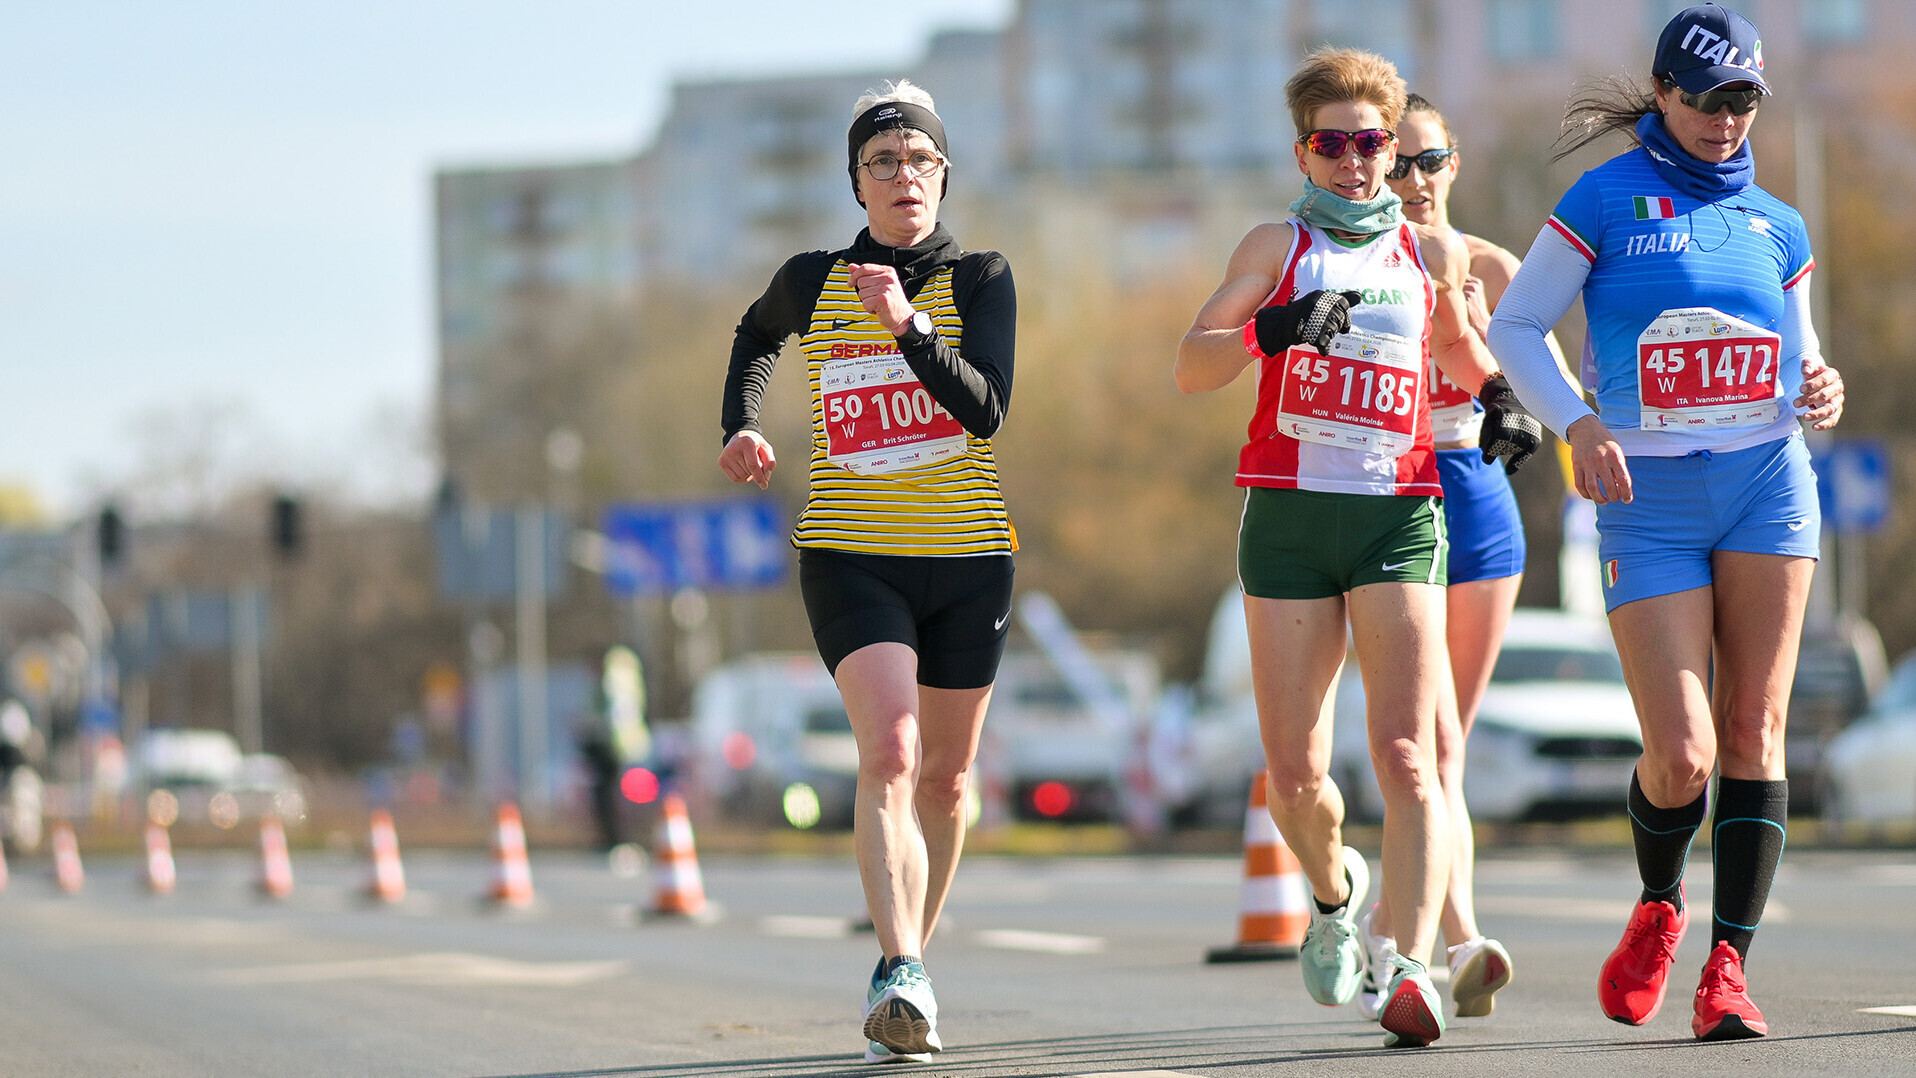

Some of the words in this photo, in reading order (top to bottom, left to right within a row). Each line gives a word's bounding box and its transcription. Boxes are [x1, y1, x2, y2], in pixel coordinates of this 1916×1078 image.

[1627, 233, 1690, 256] ITALIA
[1646, 348, 1686, 374] 45
[1694, 344, 1773, 388] 1472
[1291, 357, 1331, 384] 45
[1339, 366, 1414, 416] 1185
[1299, 384, 1317, 402] W
[1657, 376, 1676, 393] W
[1695, 396, 1723, 404] Ivanova
[1724, 394, 1748, 402] Marina
[830, 394, 863, 423] 50
[1312, 408, 1329, 417] HUN
[1335, 412, 1359, 422] Valéria
[1360, 416, 1384, 426] Molnár
[841, 422, 856, 439] W
[861, 440, 877, 448] GER
[883, 437, 897, 445] Brit
[897, 433, 927, 443] Schröter
